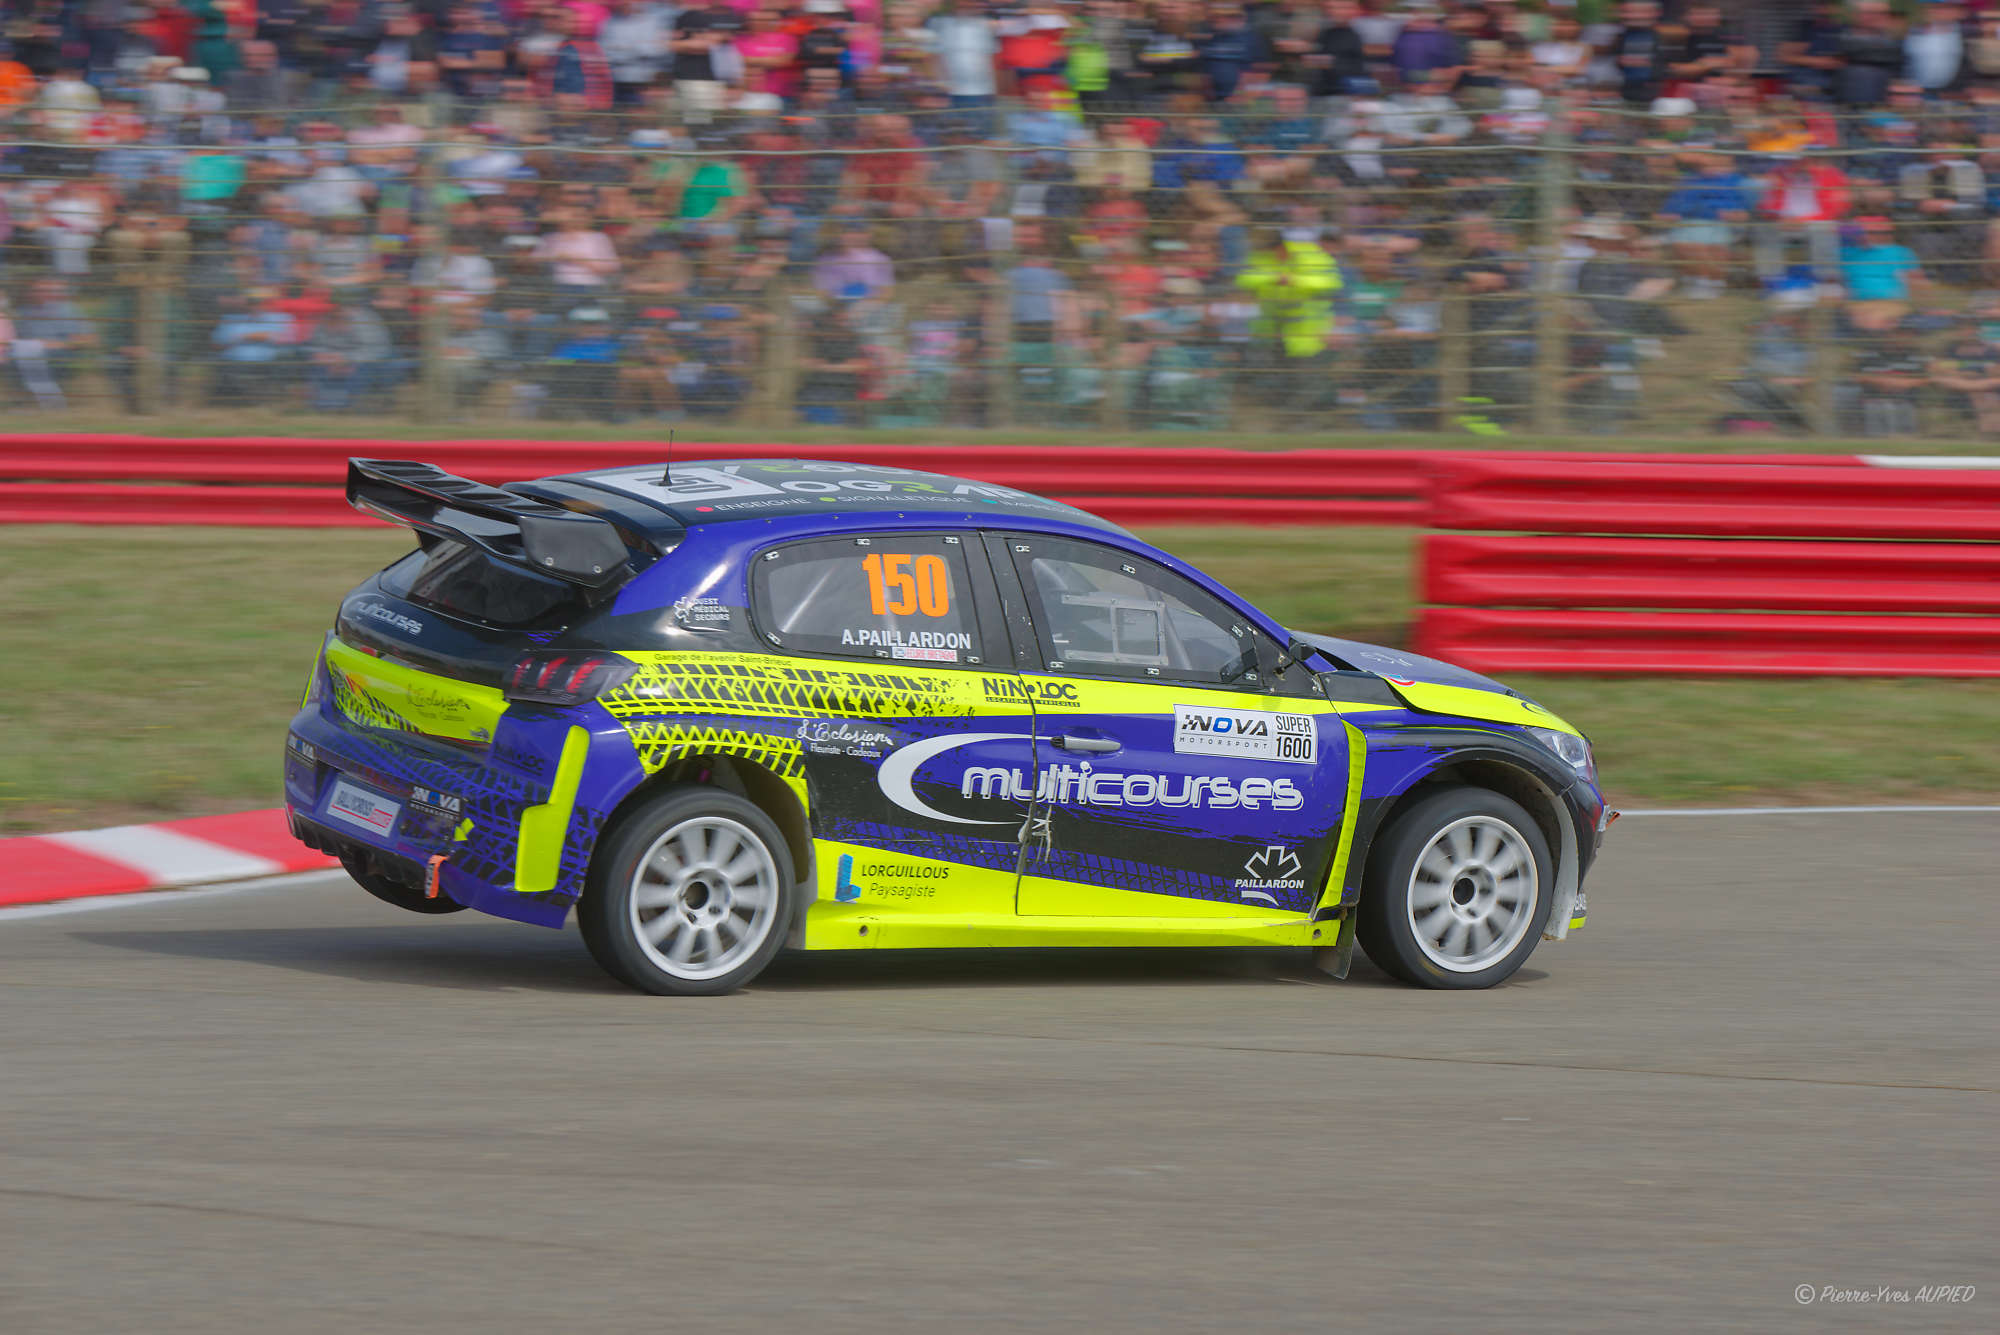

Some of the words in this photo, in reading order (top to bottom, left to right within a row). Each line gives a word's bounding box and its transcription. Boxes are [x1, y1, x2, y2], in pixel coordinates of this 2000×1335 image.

[862, 553, 950, 617] 150
[695, 613, 730, 621] SECOURS
[841, 628, 972, 650] A.PAILLARDON
[655, 653, 687, 662] Garage
[690, 653, 701, 661] de
[1275, 715, 1312, 733] SUPER
[1179, 736, 1268, 750] MOTORSPORT
[1275, 736, 1312, 759] 1600
[961, 760, 1304, 811] multicourses
[861, 864, 949, 879] LORGUILLOUS
[868, 882, 936, 900] Paysagiste
[1234, 878, 1305, 889] PAILLARDON
